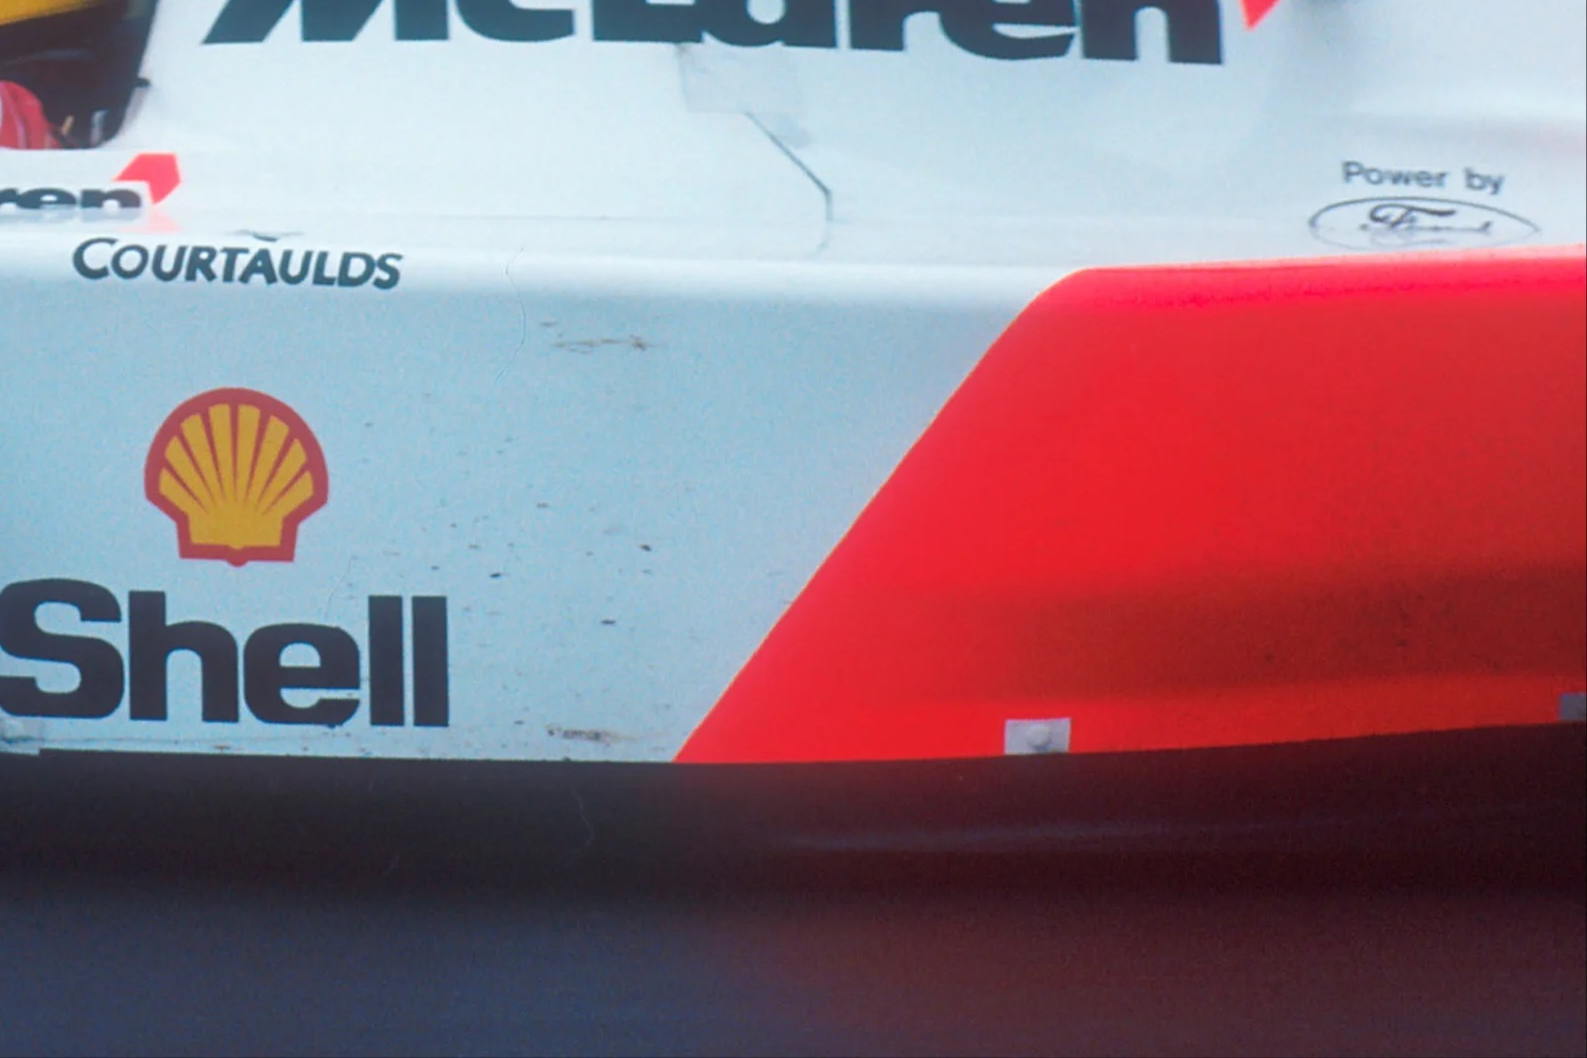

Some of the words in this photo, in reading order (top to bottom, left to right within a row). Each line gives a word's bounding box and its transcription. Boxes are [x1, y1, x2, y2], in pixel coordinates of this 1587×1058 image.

[1342, 160, 1448, 187] Power
[1464, 167, 1505, 195] by
[72, 237, 404, 290] COURTAULDS
